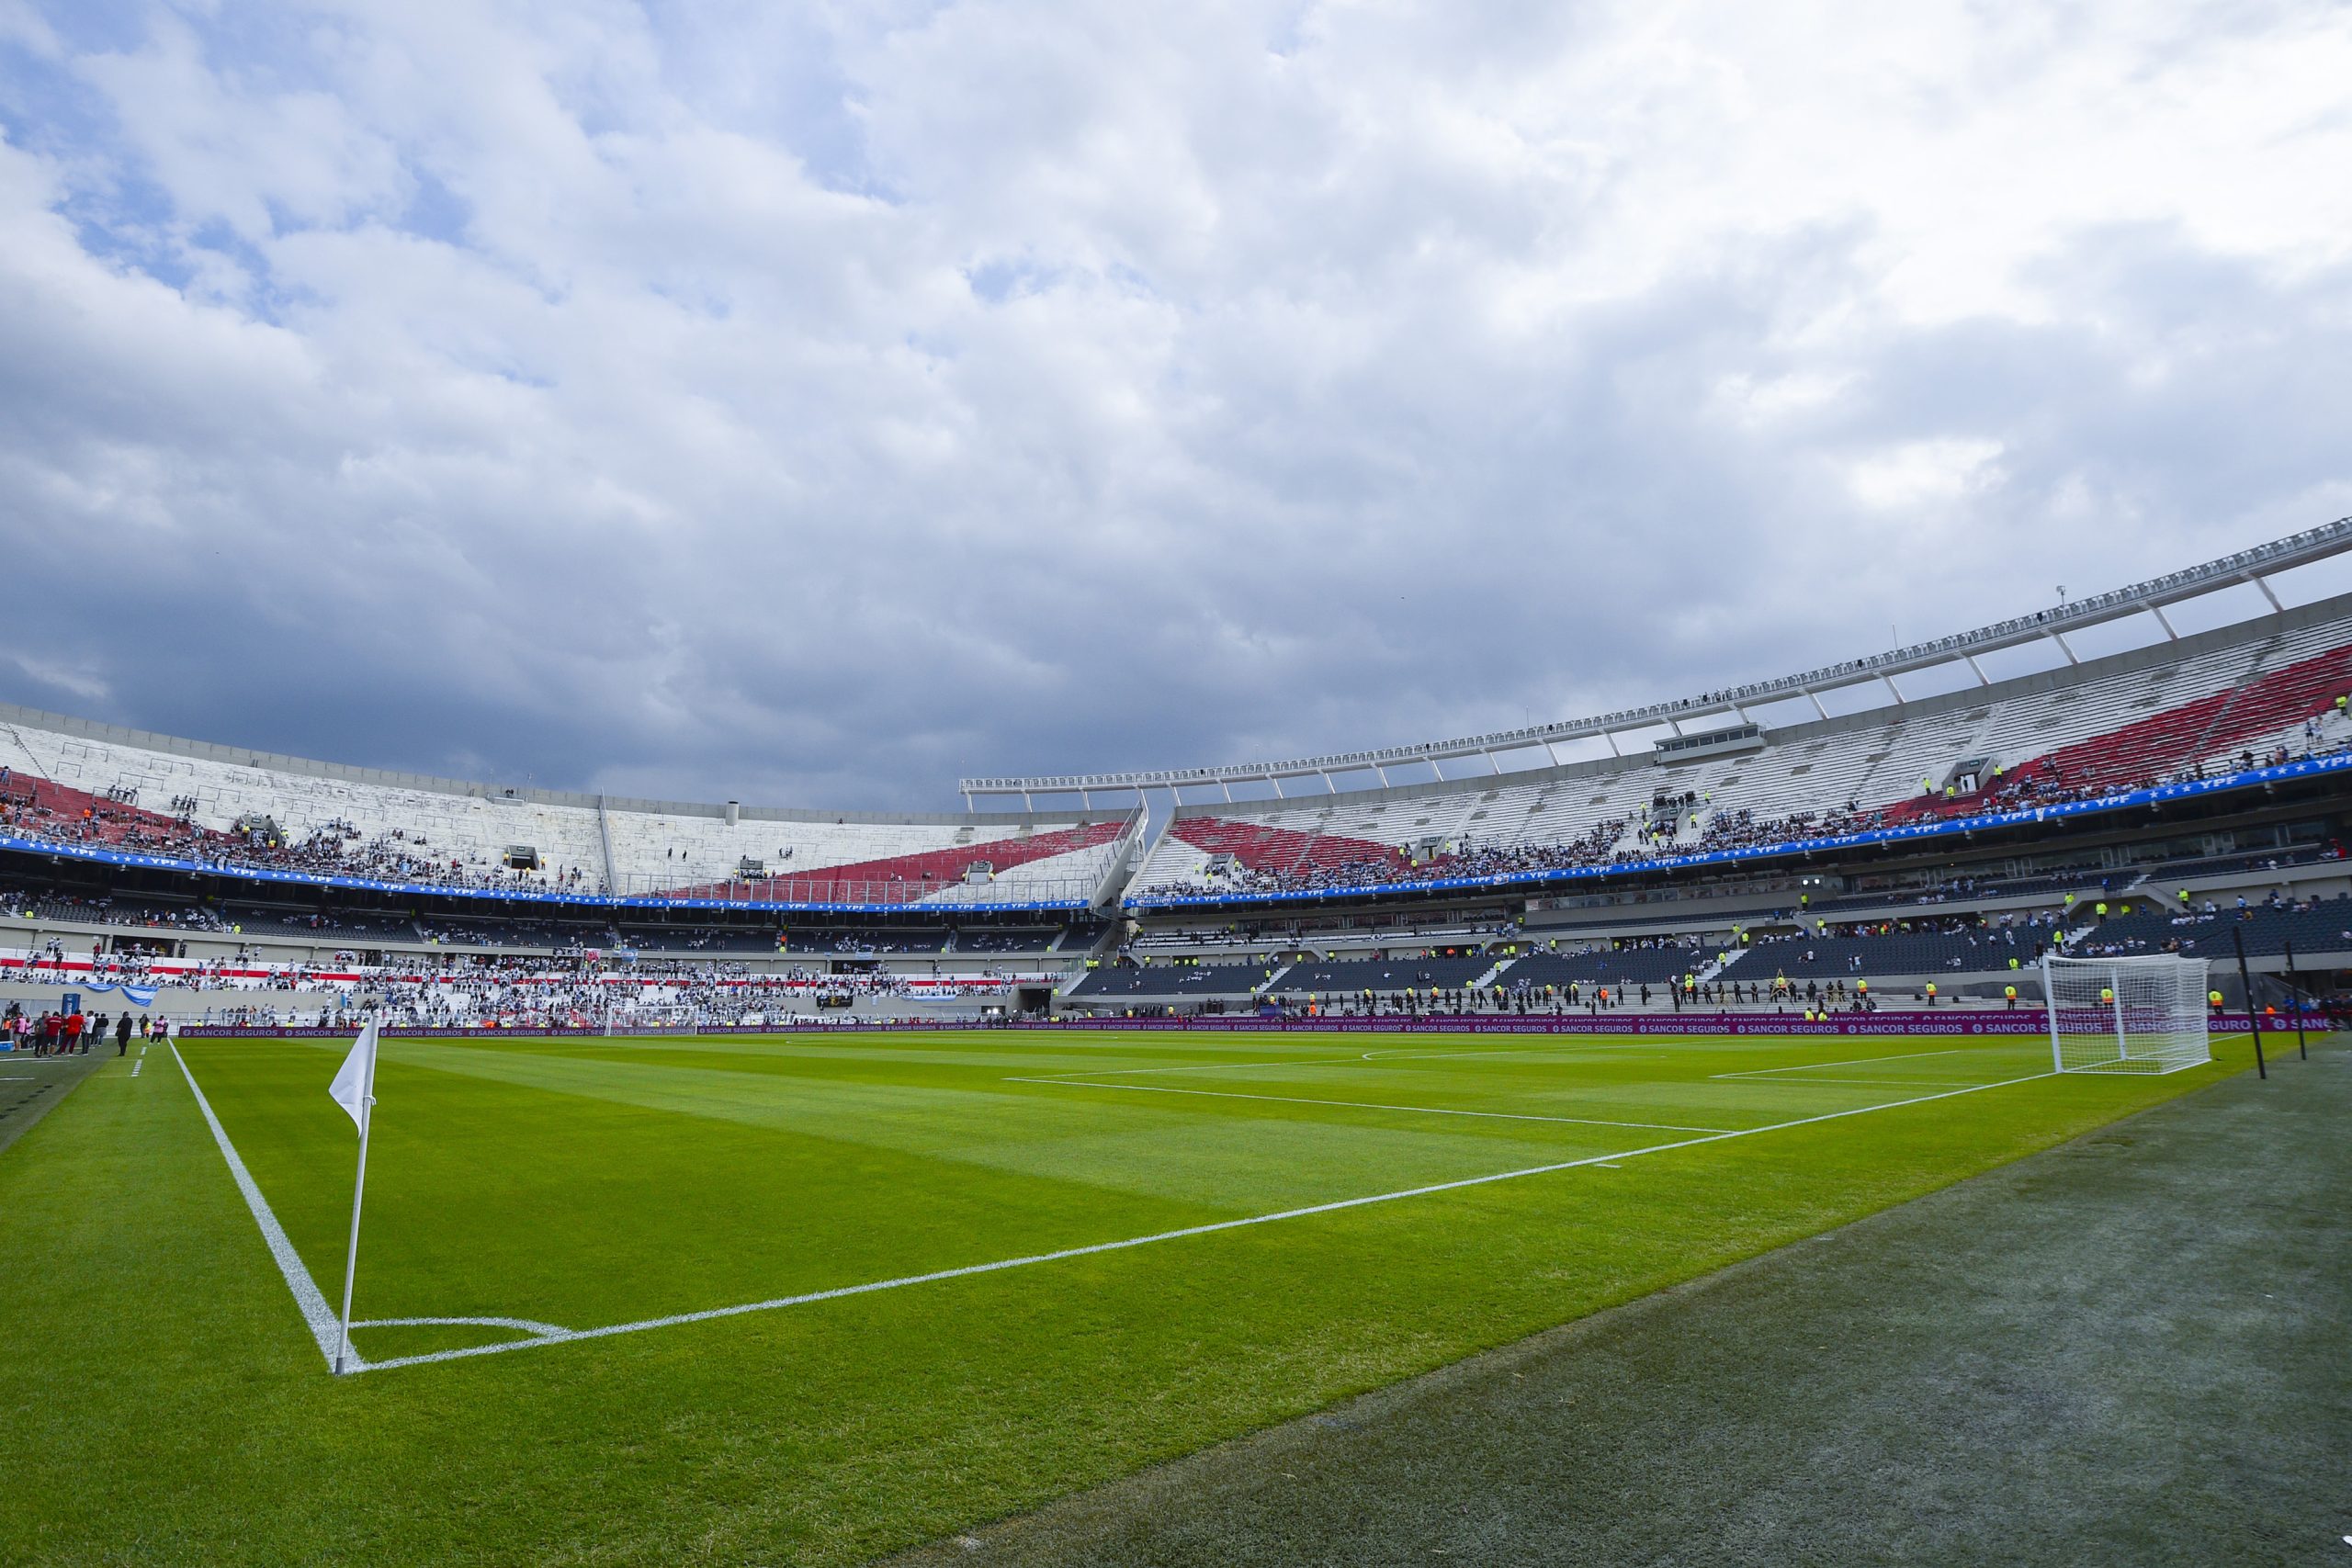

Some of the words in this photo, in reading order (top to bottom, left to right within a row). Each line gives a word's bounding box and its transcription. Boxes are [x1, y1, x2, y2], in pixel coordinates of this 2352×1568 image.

[2199, 774, 2238, 788] YPF
[2095, 794, 2131, 807] YPF
[2000, 810, 2031, 821] YPF
[1913, 824, 1942, 833] YPF
[1832, 835, 1859, 845] YPF
[68, 847, 97, 856] YPF
[1756, 842, 1782, 852] YPF
[1686, 853, 1710, 862] YPF
[231, 867, 257, 876] YPF
[1908, 1024, 1962, 1032] SEGUROS
[1986, 1024, 2037, 1032] SANCOR
